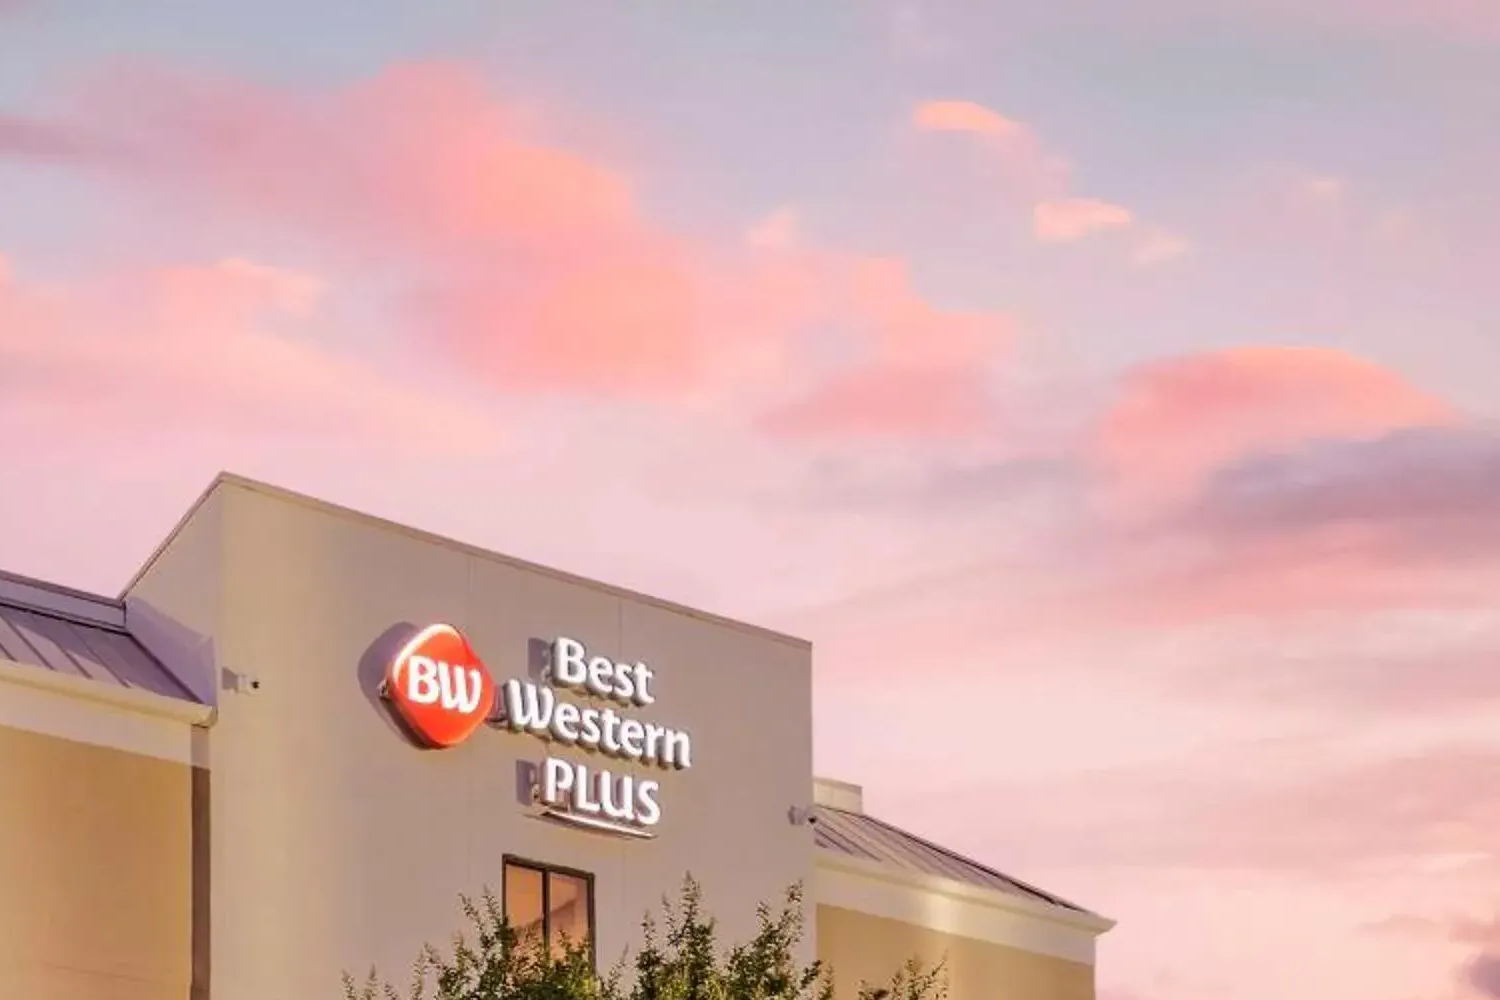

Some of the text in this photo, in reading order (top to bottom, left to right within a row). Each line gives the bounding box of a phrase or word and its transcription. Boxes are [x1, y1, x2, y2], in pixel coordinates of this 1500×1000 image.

[407, 655, 482, 713] BW
[555, 637, 655, 705] Best
[504, 678, 691, 768] Western
[541, 757, 661, 826] PLUS
